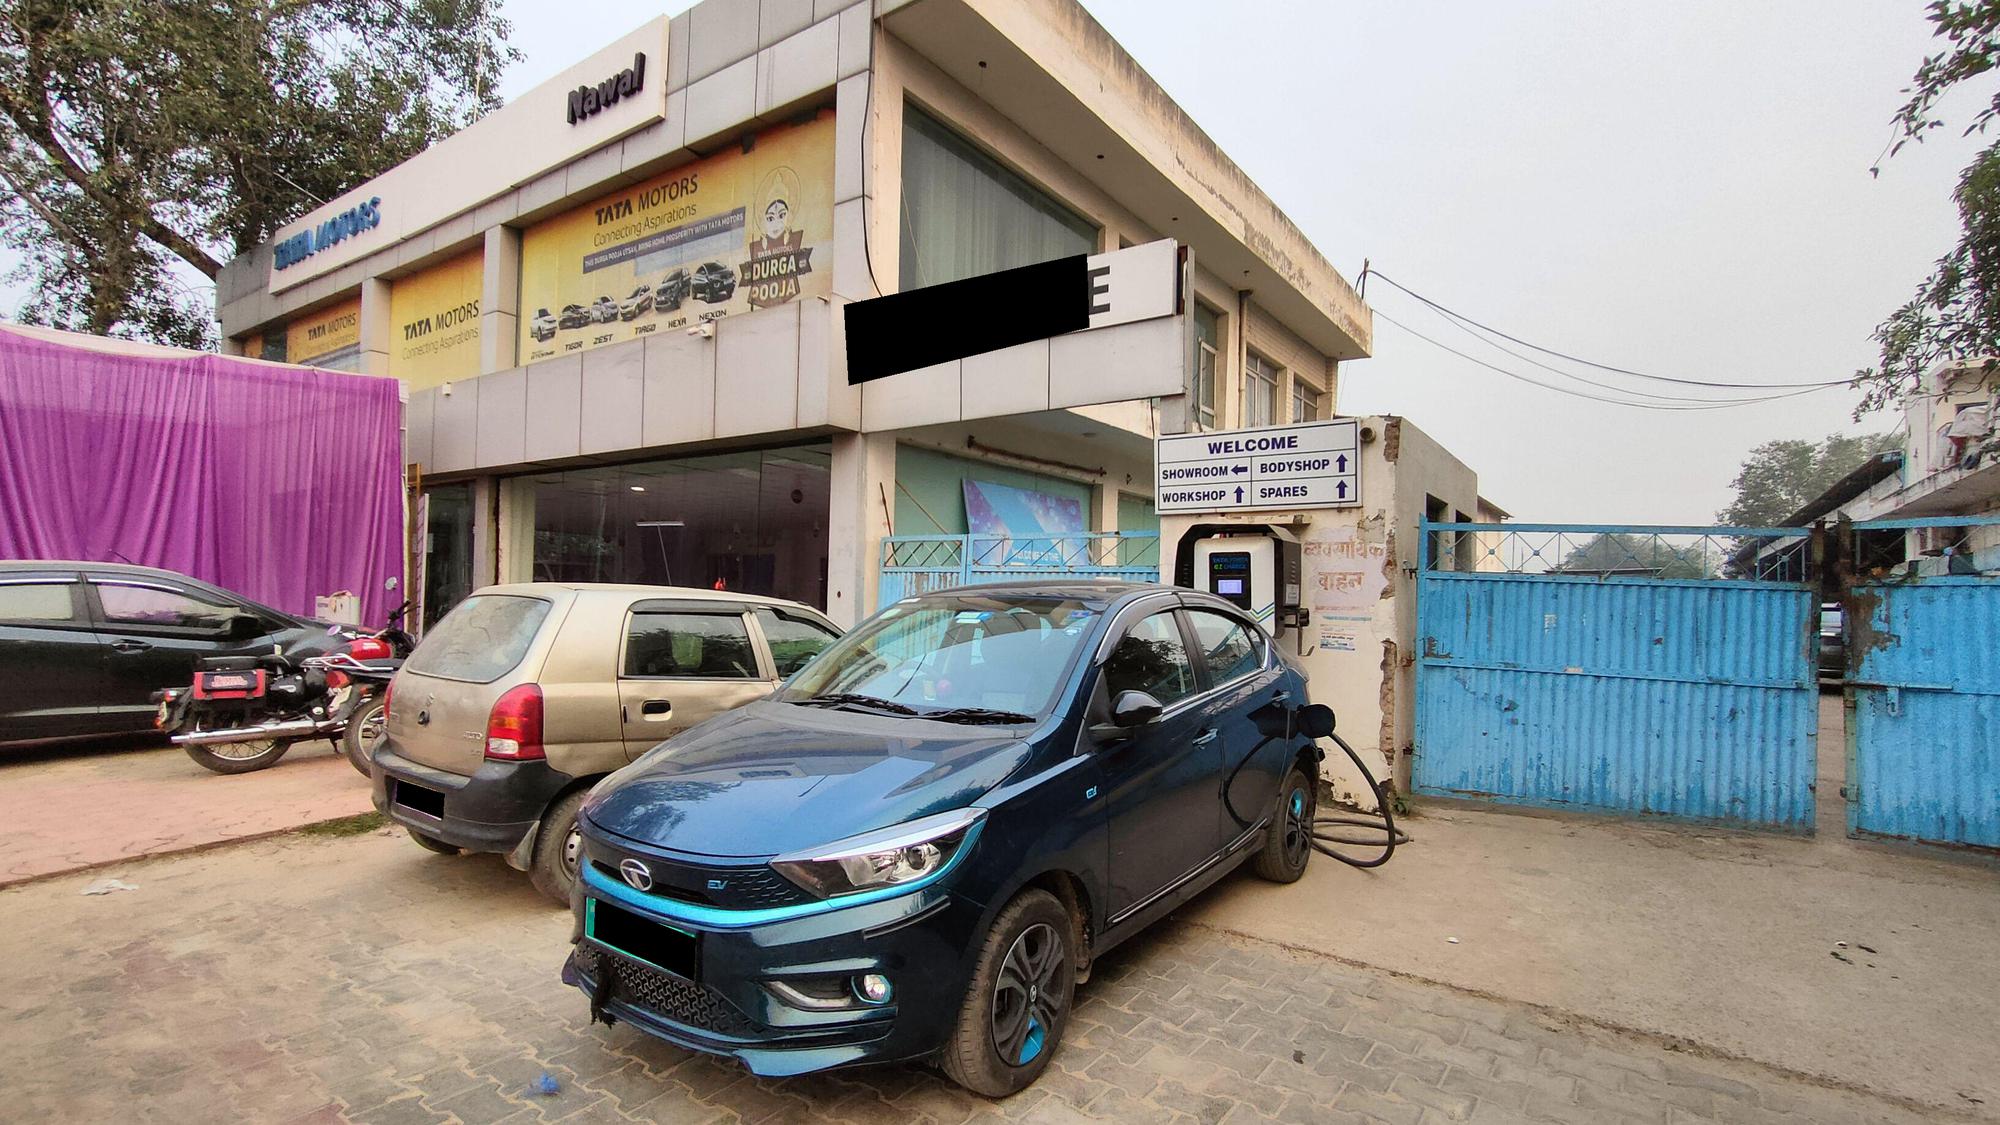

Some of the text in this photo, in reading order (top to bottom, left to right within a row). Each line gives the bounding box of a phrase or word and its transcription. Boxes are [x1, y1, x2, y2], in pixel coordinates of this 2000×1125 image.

[567, 51, 645, 125] Nawal
[595, 173, 699, 226] TATA MOTORS
[314, 195, 382, 253] MOTORS
[593, 201, 697, 248] Connecting Aspirations
[708, 219, 722, 232] TATA
[722, 213, 744, 228] MOTORS
[752, 254, 796, 281] DURGA
[752, 278, 796, 301] POOJA
[403, 299, 479, 341] TATA MOTORS
[668, 317, 687, 328] HEXA
[698, 309, 727, 322] NEXON
[308, 312, 356, 341] TATA MOTORS
[635, 324, 656, 335] TIAGO
[565, 340, 583, 352] TIGOR
[593, 334, 613, 345] ZEST
[1208, 435, 1298, 454] WELCOME
[1162, 465, 1228, 480] SHOWROOM
[1260, 459, 1330, 474] BODYSHOP
[1162, 490, 1227, 503] WORKSHOP
[1260, 485, 1308, 498] SPARES
[706, 878, 729, 890] EV
